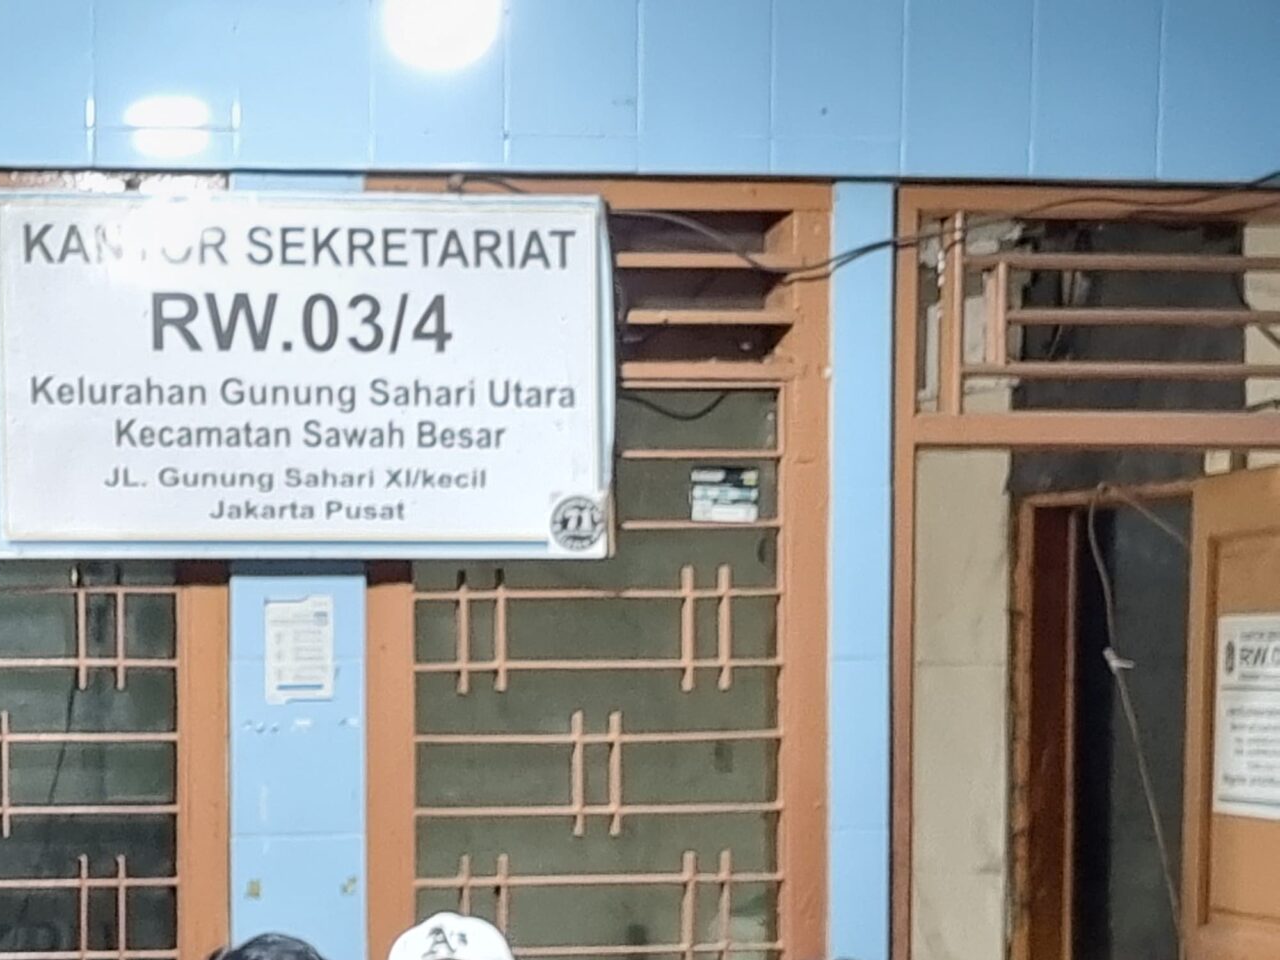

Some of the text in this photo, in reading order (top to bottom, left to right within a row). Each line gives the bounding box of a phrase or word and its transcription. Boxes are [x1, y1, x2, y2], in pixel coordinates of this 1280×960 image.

[23, 222, 577, 270] KANR SEKRETARIAT
[151, 291, 453, 355] RW.03/4
[30, 376, 576, 414] Kelurahan Gunung Sahari Utara
[114, 418, 506, 450] Kecamatan Sawah Besar
[104, 466, 487, 493] JL. Gunung Sahari XI/kecil
[209, 500, 406, 521] Jakarta Pusat
